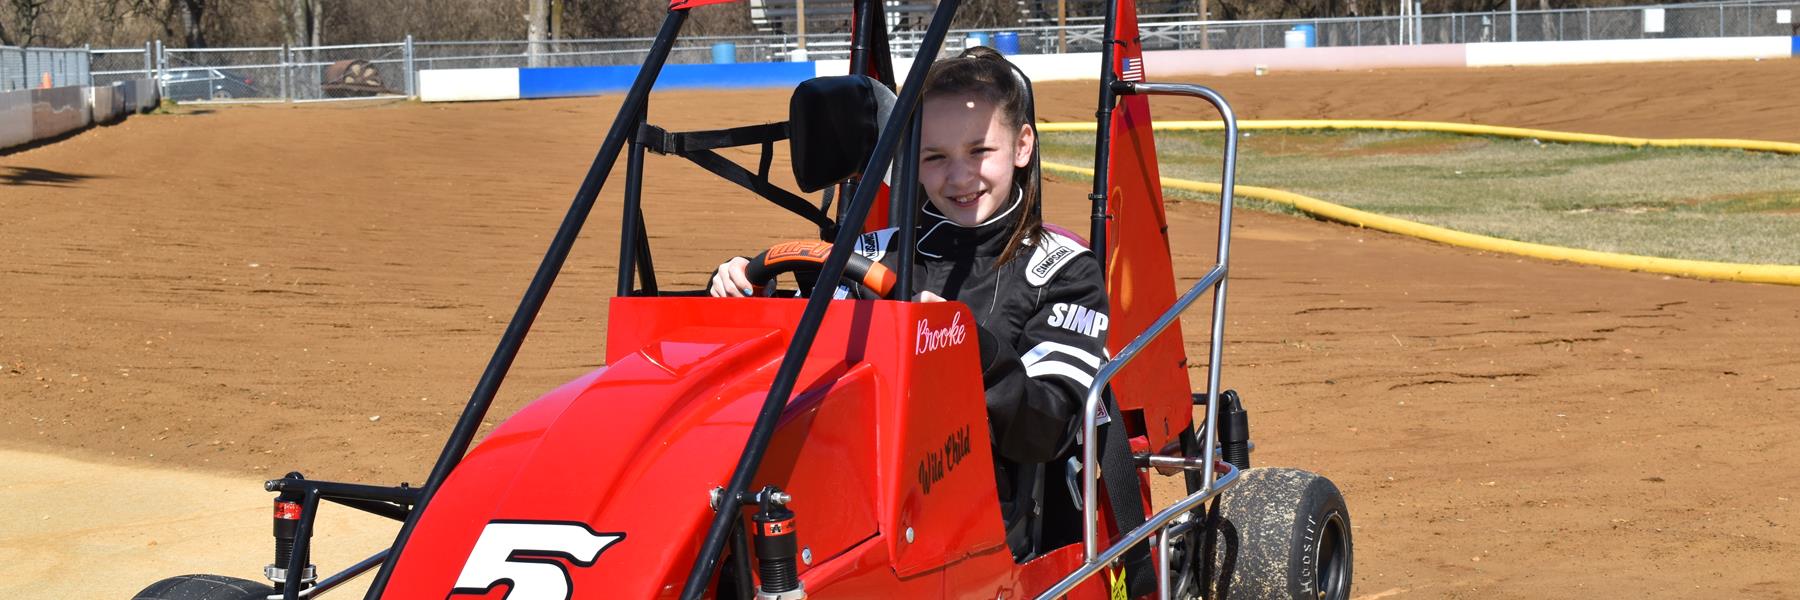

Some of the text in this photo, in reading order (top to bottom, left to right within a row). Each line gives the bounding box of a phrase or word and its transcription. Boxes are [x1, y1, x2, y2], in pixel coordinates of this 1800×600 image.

[1036, 248, 1068, 275] SIMPSON
[915, 311, 966, 355] Brooke
[1047, 302, 1109, 338] SIMP
[918, 423, 971, 495] Wild Child
[445, 519, 627, 600] 5
